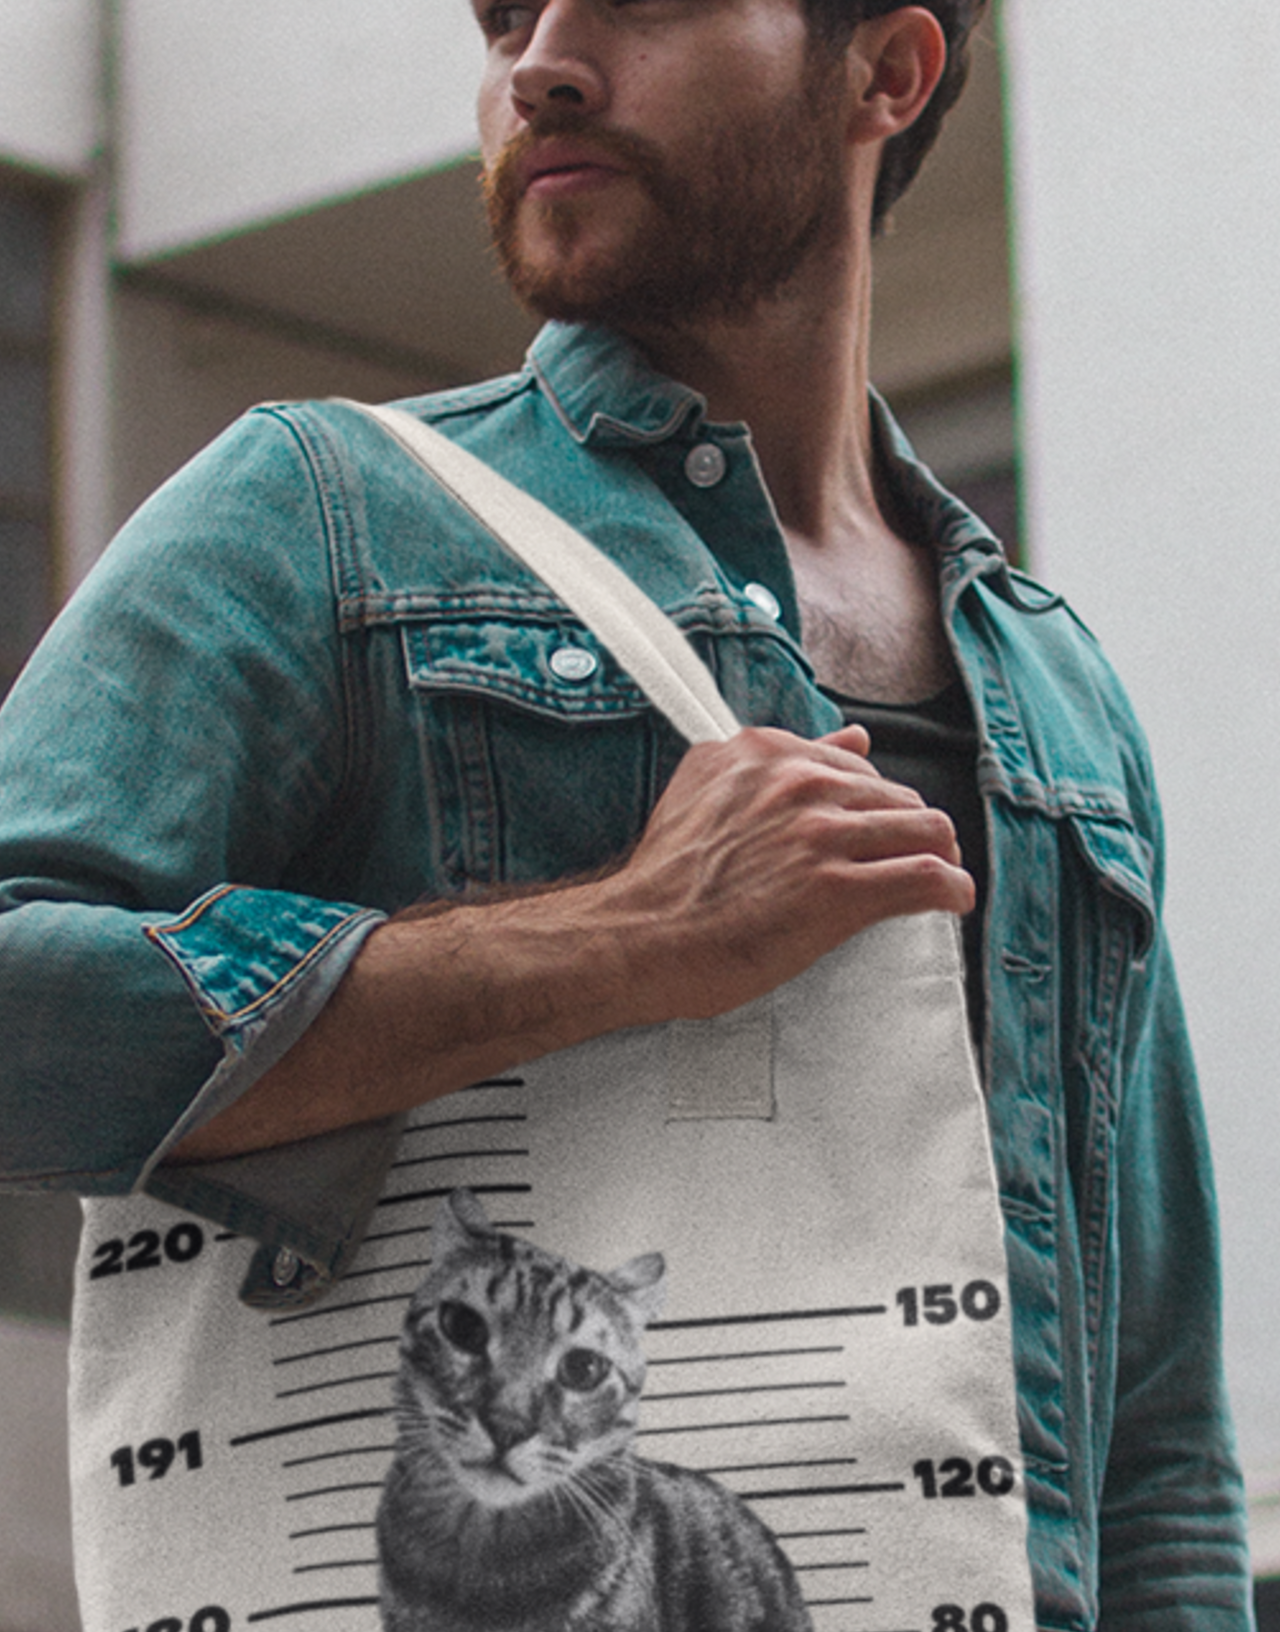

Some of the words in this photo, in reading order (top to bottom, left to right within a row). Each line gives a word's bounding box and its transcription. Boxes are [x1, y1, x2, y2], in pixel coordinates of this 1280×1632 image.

[89, 1221, 205, 1280] 220
[895, 1279, 1003, 1327] 150
[110, 1429, 205, 1487] 191
[912, 1455, 1015, 1499] 120
